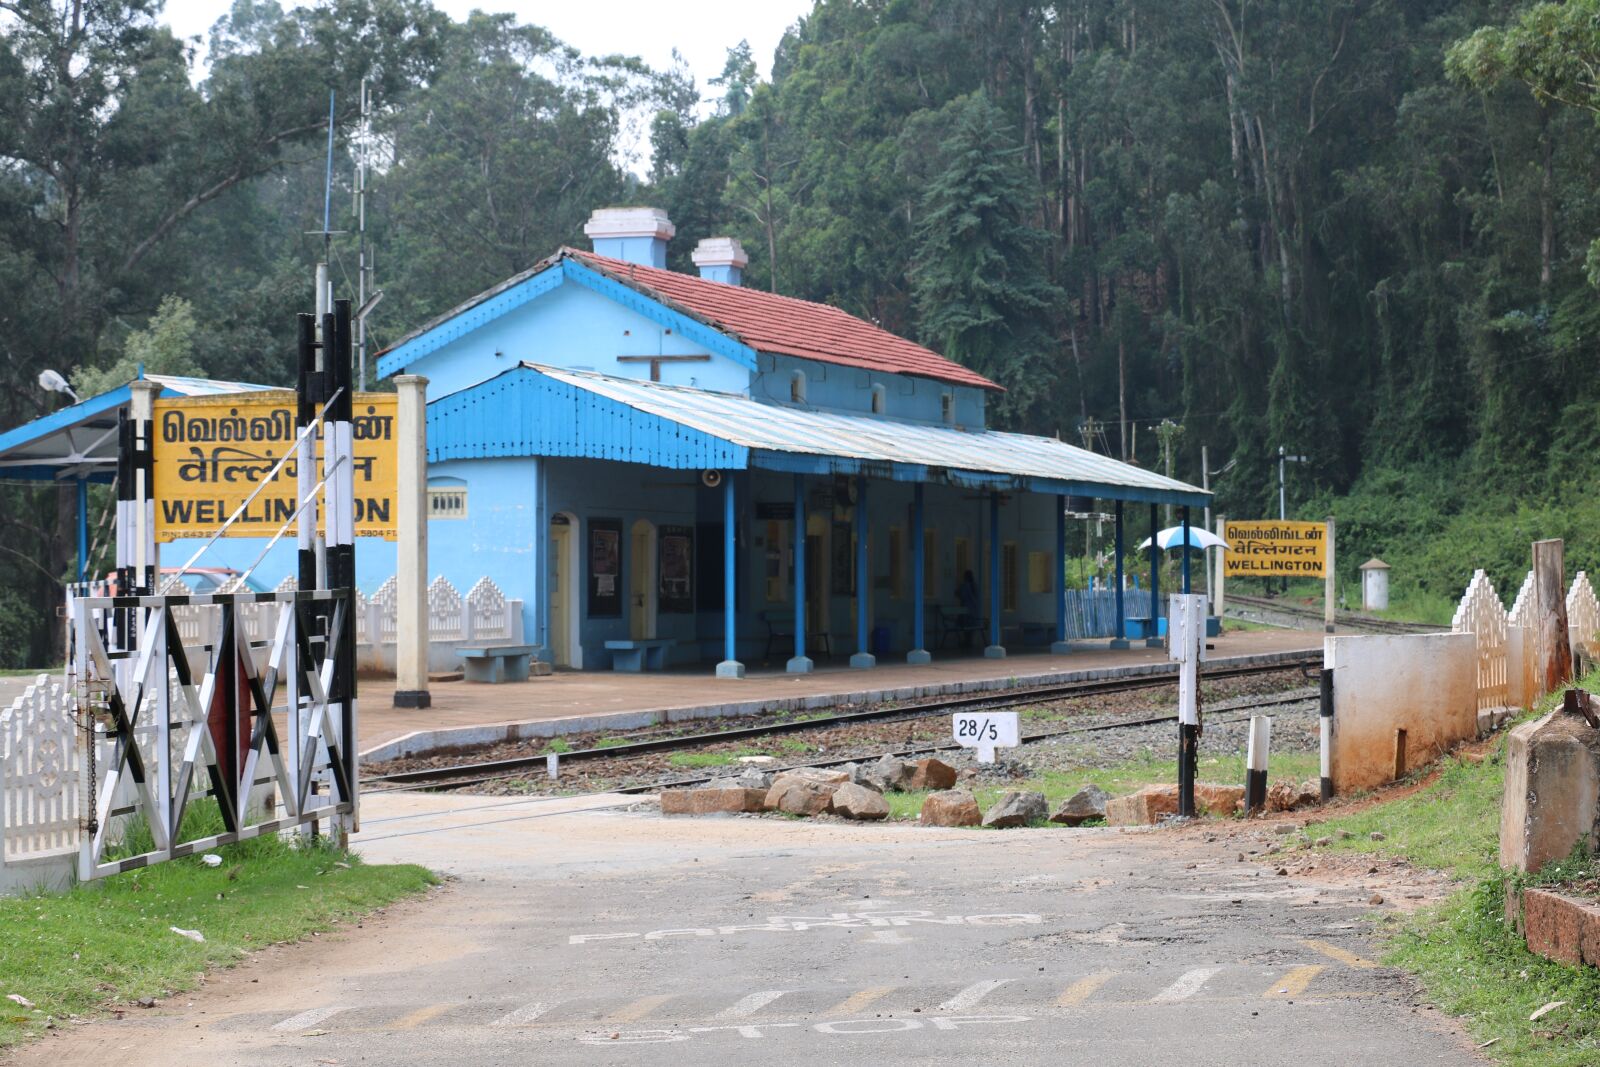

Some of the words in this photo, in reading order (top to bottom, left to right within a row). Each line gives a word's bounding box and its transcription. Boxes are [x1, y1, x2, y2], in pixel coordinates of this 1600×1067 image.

[162, 498, 390, 523] WELLINON
[1228, 560, 1322, 571] WELLINGTON
[959, 718, 997, 741] 28/5
[578, 1015, 1033, 1045] STOP
